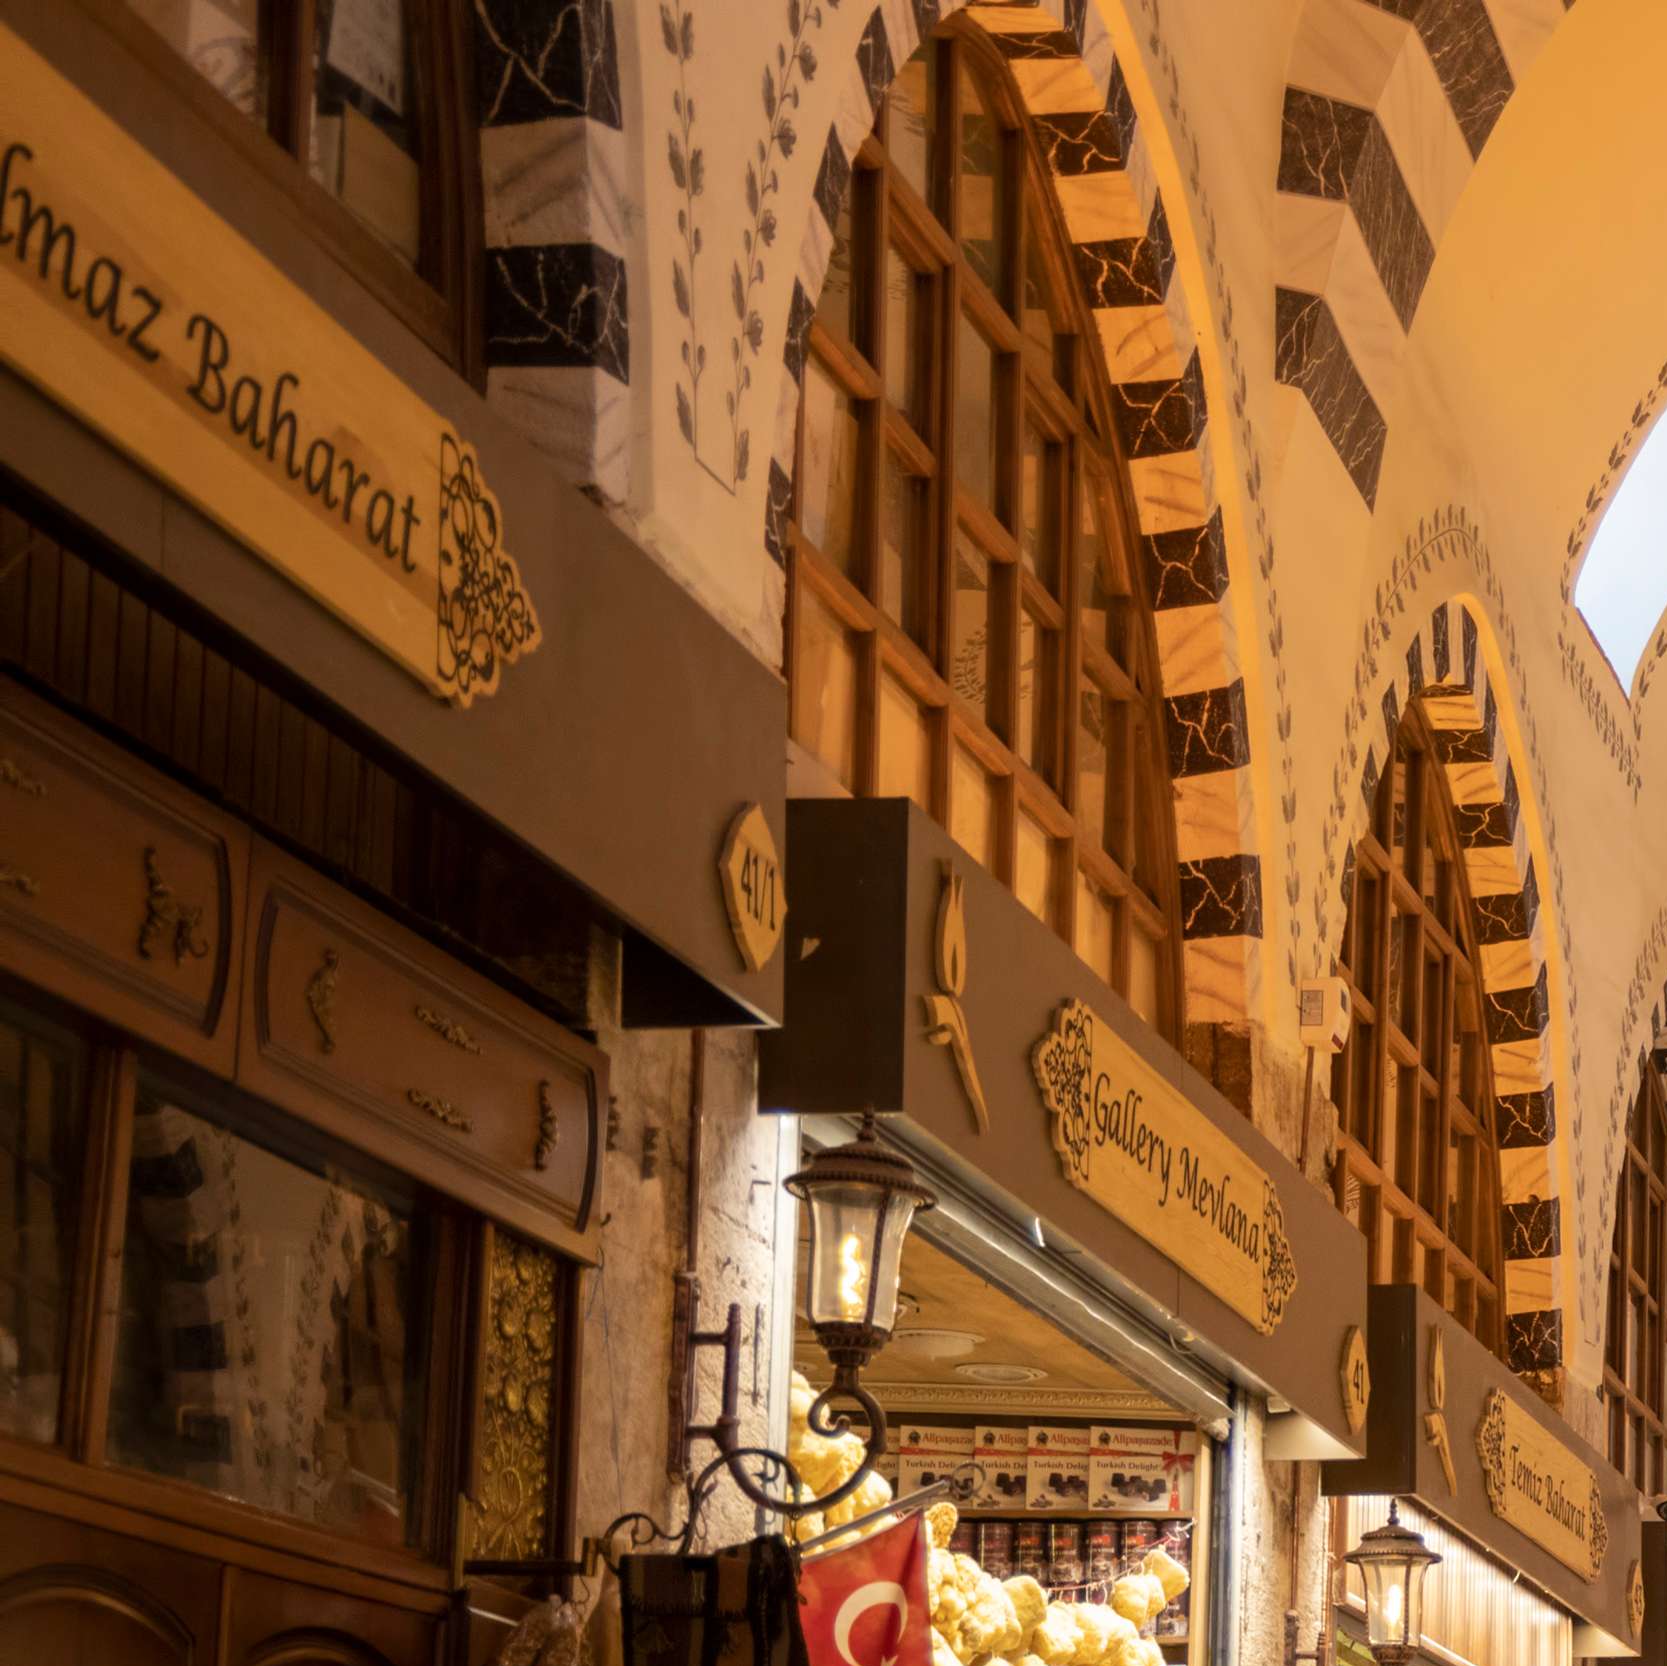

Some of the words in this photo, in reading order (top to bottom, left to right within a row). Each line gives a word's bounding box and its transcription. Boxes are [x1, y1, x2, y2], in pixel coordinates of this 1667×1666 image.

[186, 314, 421, 573] Baharat
[740, 847, 776, 932] 41/1
[1093, 1072, 1173, 1203] Gallery
[1176, 1147, 1262, 1265] Mevlana
[1353, 1358, 1365, 1405] 41
[922, 1431, 974, 1448] Alipaşaza
[1095, 1460, 1127, 1470] Turkish
[1129, 1460, 1160, 1472] Delight
[1509, 1445, 1543, 1503] Temiz
[1544, 1474, 1586, 1542] Baharat
